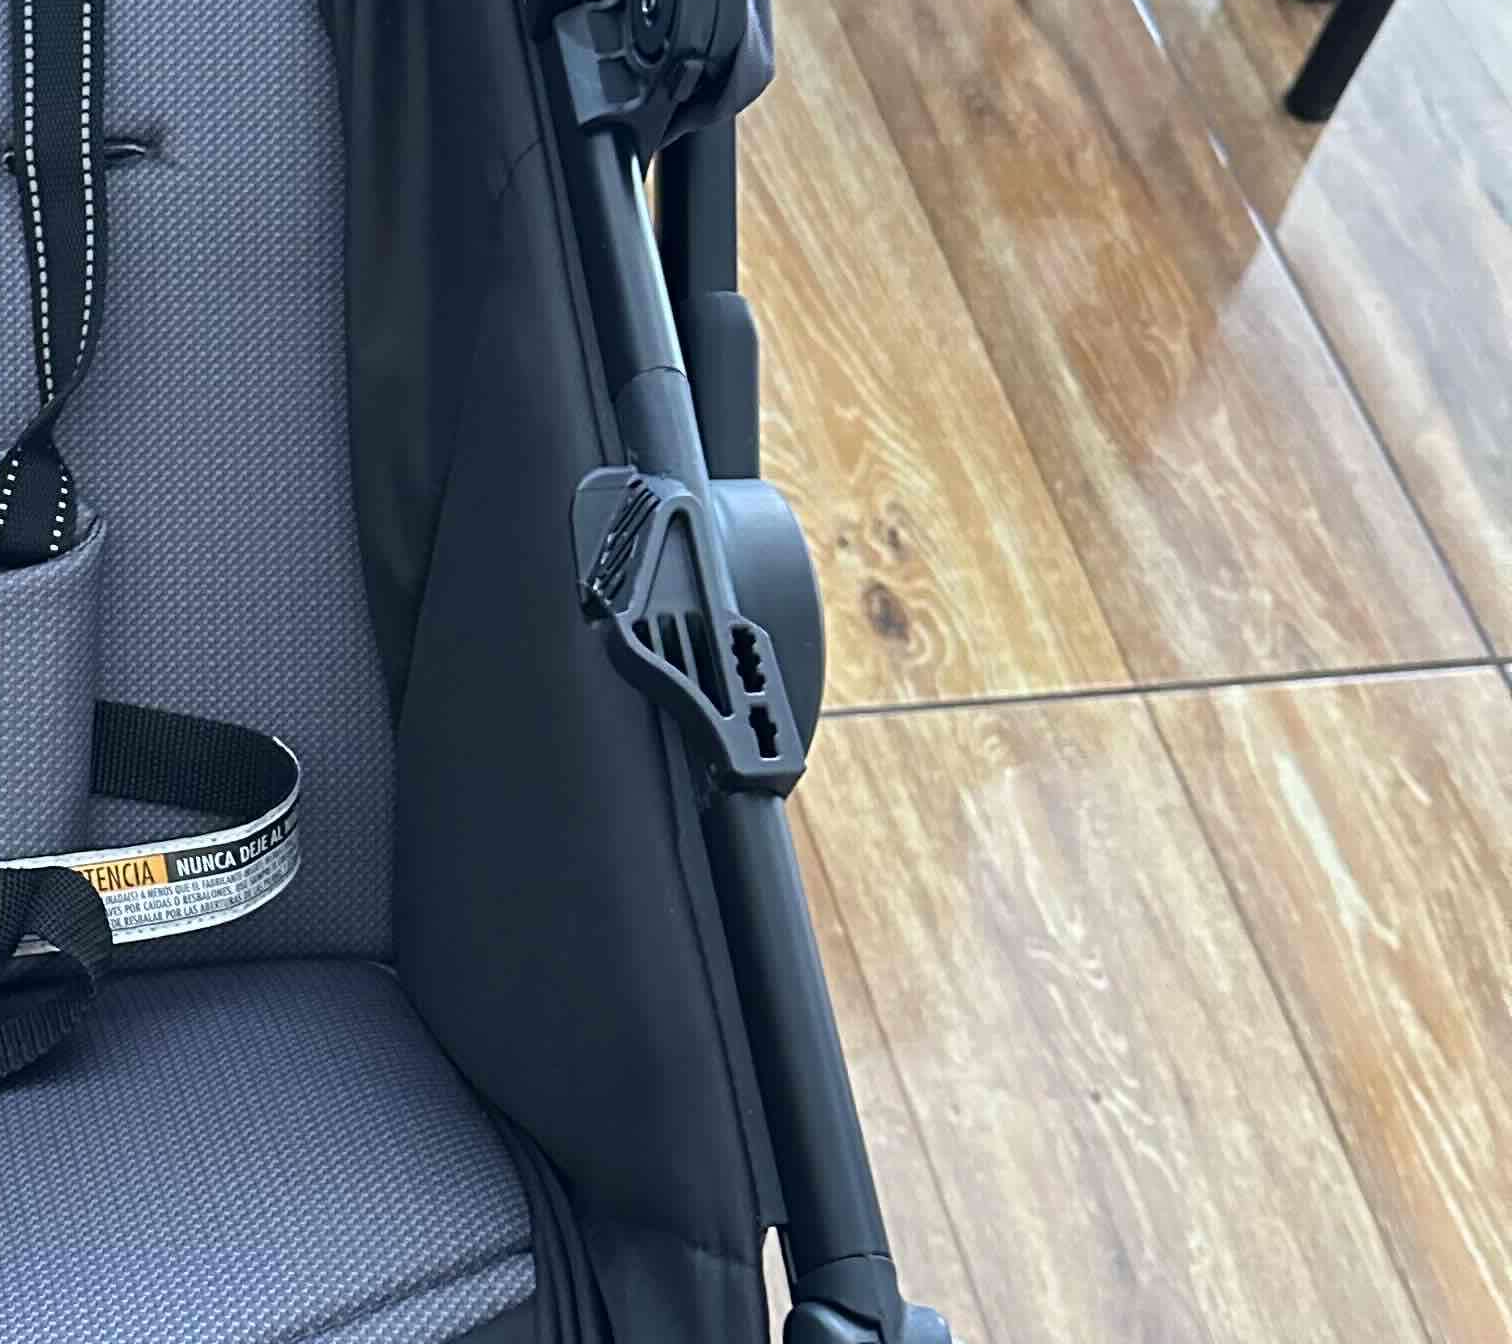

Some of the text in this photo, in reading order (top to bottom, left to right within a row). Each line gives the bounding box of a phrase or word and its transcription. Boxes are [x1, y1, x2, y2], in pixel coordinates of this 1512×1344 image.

[176, 851, 237, 877] NUNCA
[239, 834, 268, 863] DEJE
[270, 825, 283, 846] AL
